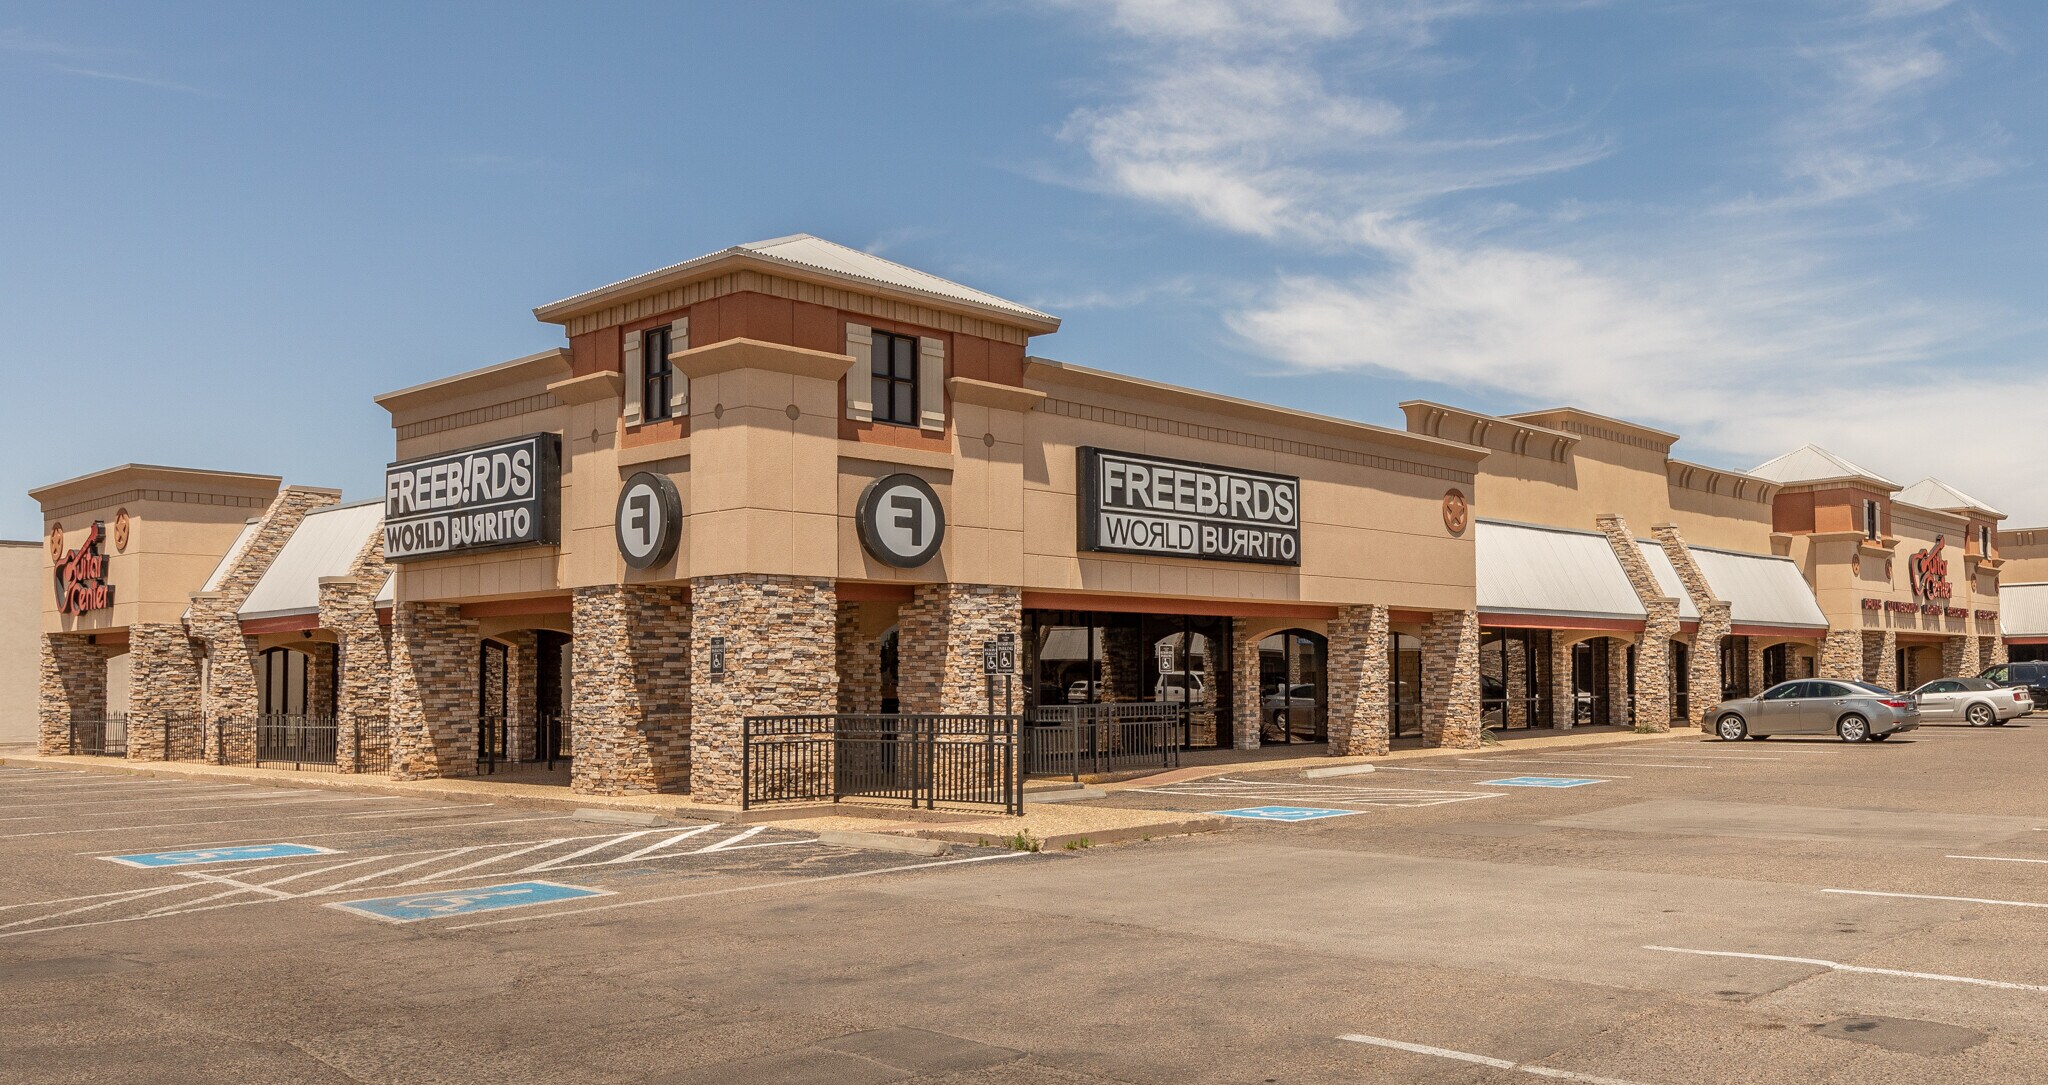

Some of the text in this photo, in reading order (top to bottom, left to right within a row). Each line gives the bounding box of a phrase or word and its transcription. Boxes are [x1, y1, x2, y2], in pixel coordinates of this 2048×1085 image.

[387, 449, 531, 516] FREEB!RDS
[1104, 460, 1294, 523] FREEB!RDS
[386, 507, 531, 553] WORLD BURRITO
[1106, 516, 1296, 560] WORLD BURRITO
[71, 581, 109, 616] Center
[1924, 573, 1953, 600] Center
